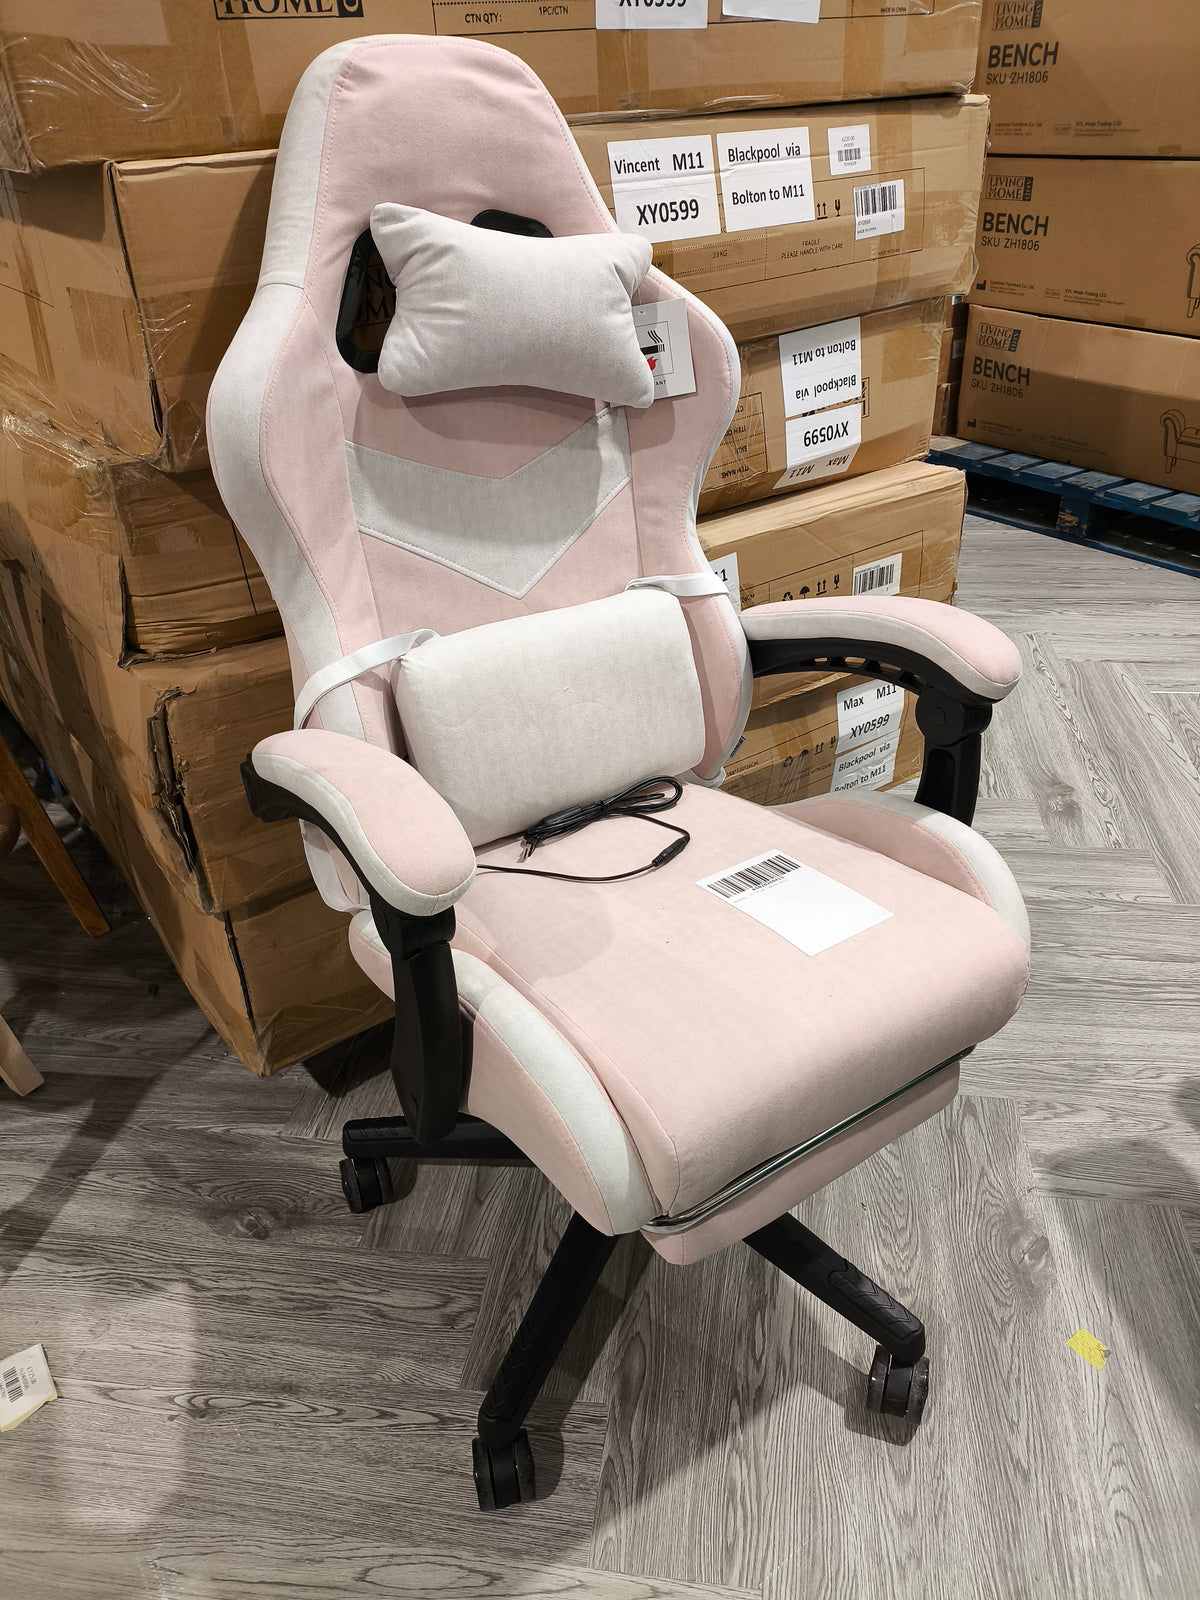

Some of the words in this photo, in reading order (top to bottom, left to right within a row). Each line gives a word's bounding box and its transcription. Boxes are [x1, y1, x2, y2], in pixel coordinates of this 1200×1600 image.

[538, 6, 568, 16] 1PC/CTN
[996, 2, 1033, 15] LIVING
[464, 13, 481, 23] CTN
[483, 12, 502, 23] QTY:
[994, 15, 1031, 28] HOME
[988, 42, 1059, 68] BENCH
[986, 72, 1007, 85] SKU
[1010, 71, 1049, 84] ZH1806
[728, 143, 780, 163] Blackpool
[785, 142, 801, 156] via
[614, 157, 660, 174] Vincent
[673, 152, 704, 171] M11
[990, 176, 1024, 188] LIVING
[732, 189, 767, 205] Bolton
[769, 187, 780, 201] to
[782, 184, 805, 199] M11
[988, 187, 1022, 200] HOME
[636, 199, 699, 226] XY0599
[982, 212, 1049, 236] BENCH
[802, 238, 821, 247] FRAGILE
[981, 236, 1000, 248] SKU
[1004, 238, 1040, 251] ZH1806
[712, 250, 728, 259] 39KG
[781, 250, 800, 260] PLEASE
[800, 248, 819, 257] HANDLE
[820, 245, 831, 254] WITH
[832, 242, 844, 251] CARE
[980, 324, 1012, 338] LIVING
[827, 339, 856, 354] Bolton
[978, 334, 1009, 349] HOME
[792, 350, 813, 365] M11
[815, 347, 825, 358] to
[973, 356, 1030, 386] BENCH
[814, 375, 857, 397] Blackpool
[971, 378, 987, 391] SKU
[990, 382, 1024, 398] ZH1806
[795, 388, 809, 401] via
[734, 425, 746, 434] ITEM
[804, 420, 849, 447] XY0599
[826, 454, 850, 467] Max
[789, 464, 815, 479] M11
[843, 695, 864, 712] Max
[876, 683, 897, 700] M11
[849, 713, 890, 740] XY0599
[838, 748, 876, 772] Blackpool
[879, 742, 891, 753] via
[860, 774, 869, 783] to
[870, 765, 886, 778] M11
